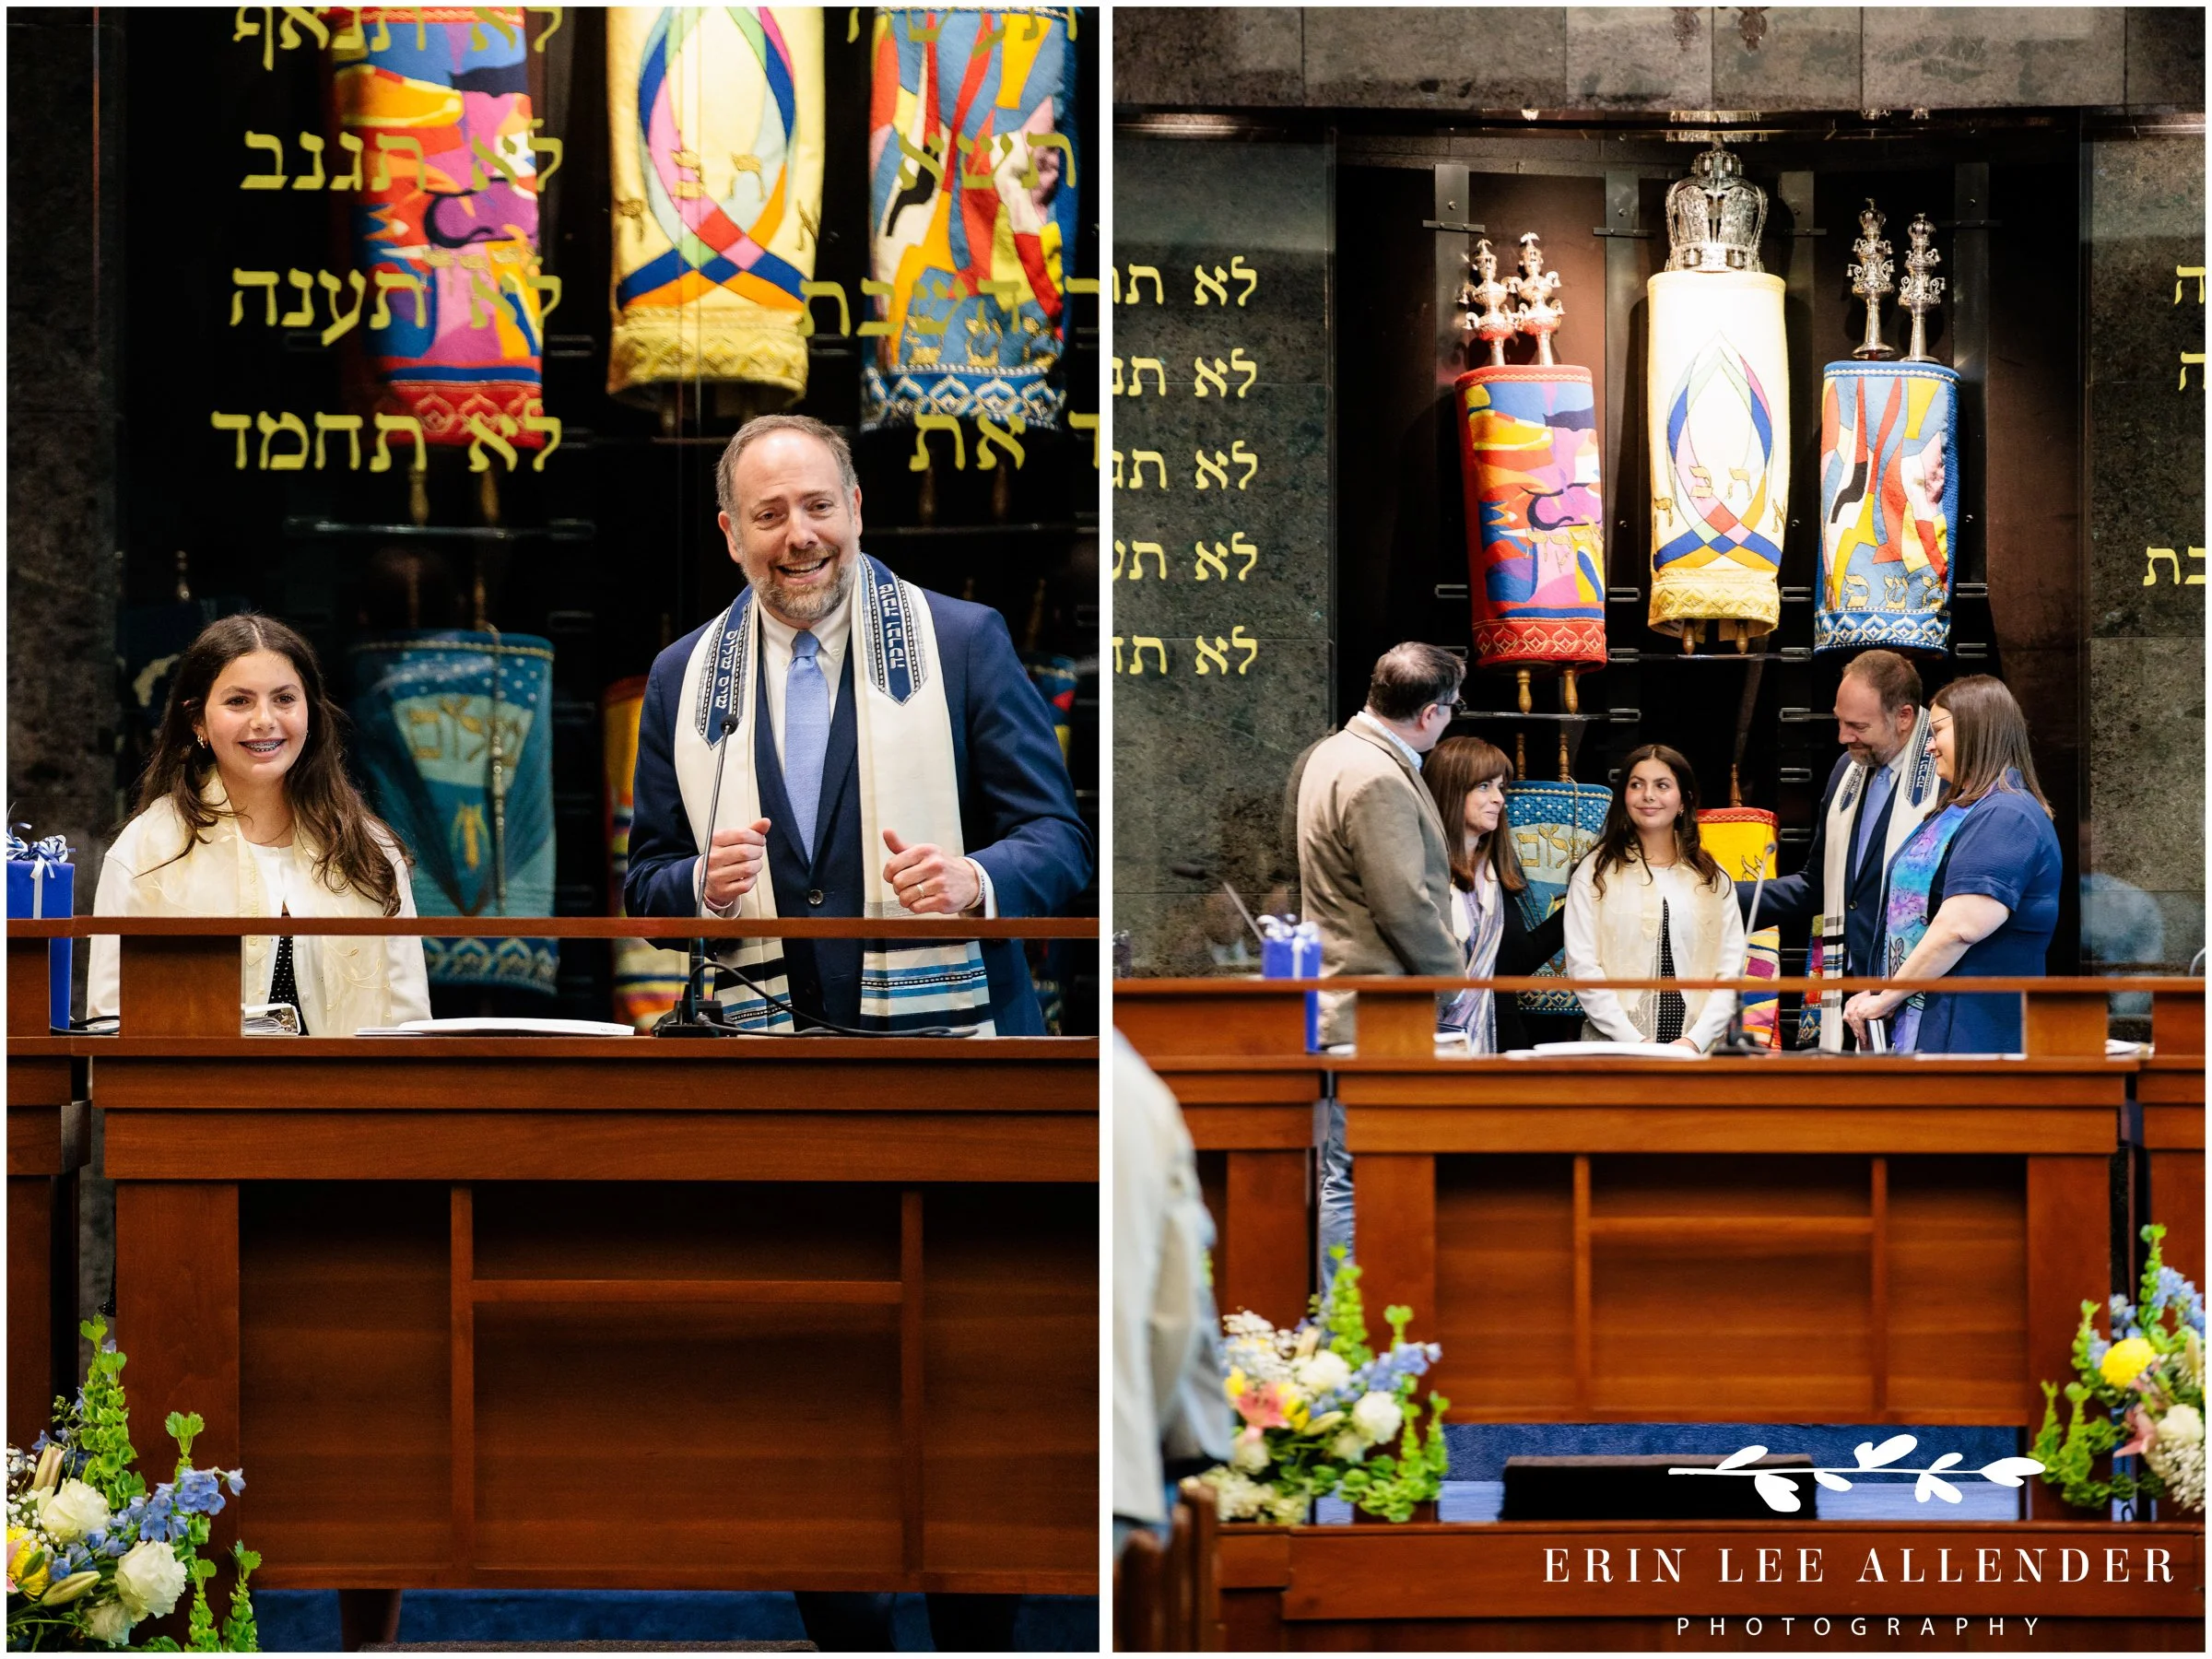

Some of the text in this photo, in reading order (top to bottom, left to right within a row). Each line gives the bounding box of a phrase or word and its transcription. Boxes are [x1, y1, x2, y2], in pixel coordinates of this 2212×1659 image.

[241, 118, 562, 192] לא תגנב
[229, 268, 427, 346] תענה
[472, 256, 562, 329] לא
[1194, 256, 1257, 306] לא
[1194, 347, 1257, 397] לא
[210, 397, 563, 472] לא תחמד
[909, 411, 1026, 472] את
[1194, 441, 1258, 490] לא
[1194, 532, 1257, 581] לא
[1194, 626, 1257, 675] לא
